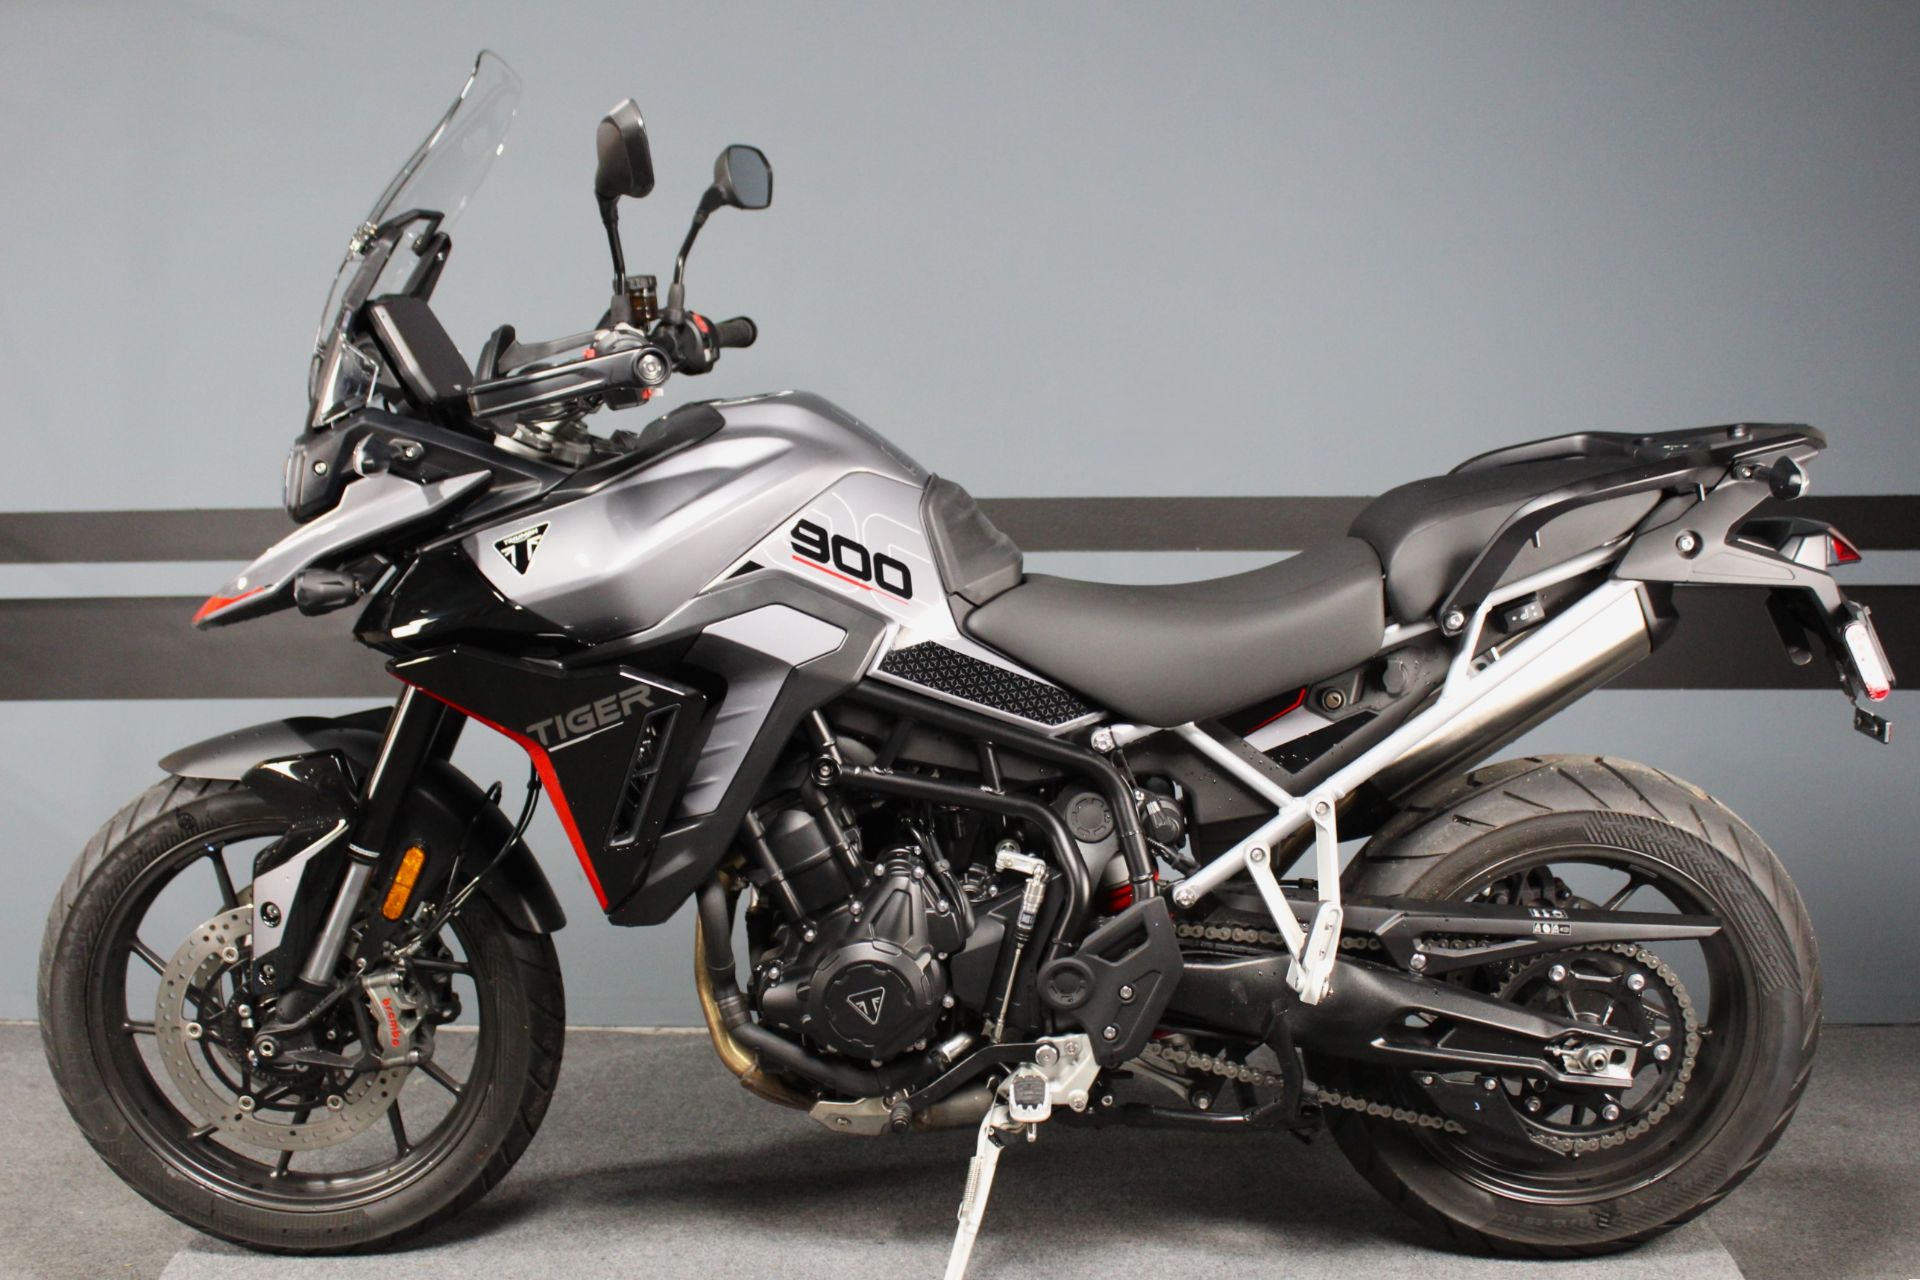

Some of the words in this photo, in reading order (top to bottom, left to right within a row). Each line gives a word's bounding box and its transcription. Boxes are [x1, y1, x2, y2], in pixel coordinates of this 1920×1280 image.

[790, 518, 913, 600] 900
[526, 684, 655, 746] TIGER
[382, 998, 400, 1048] brembo
